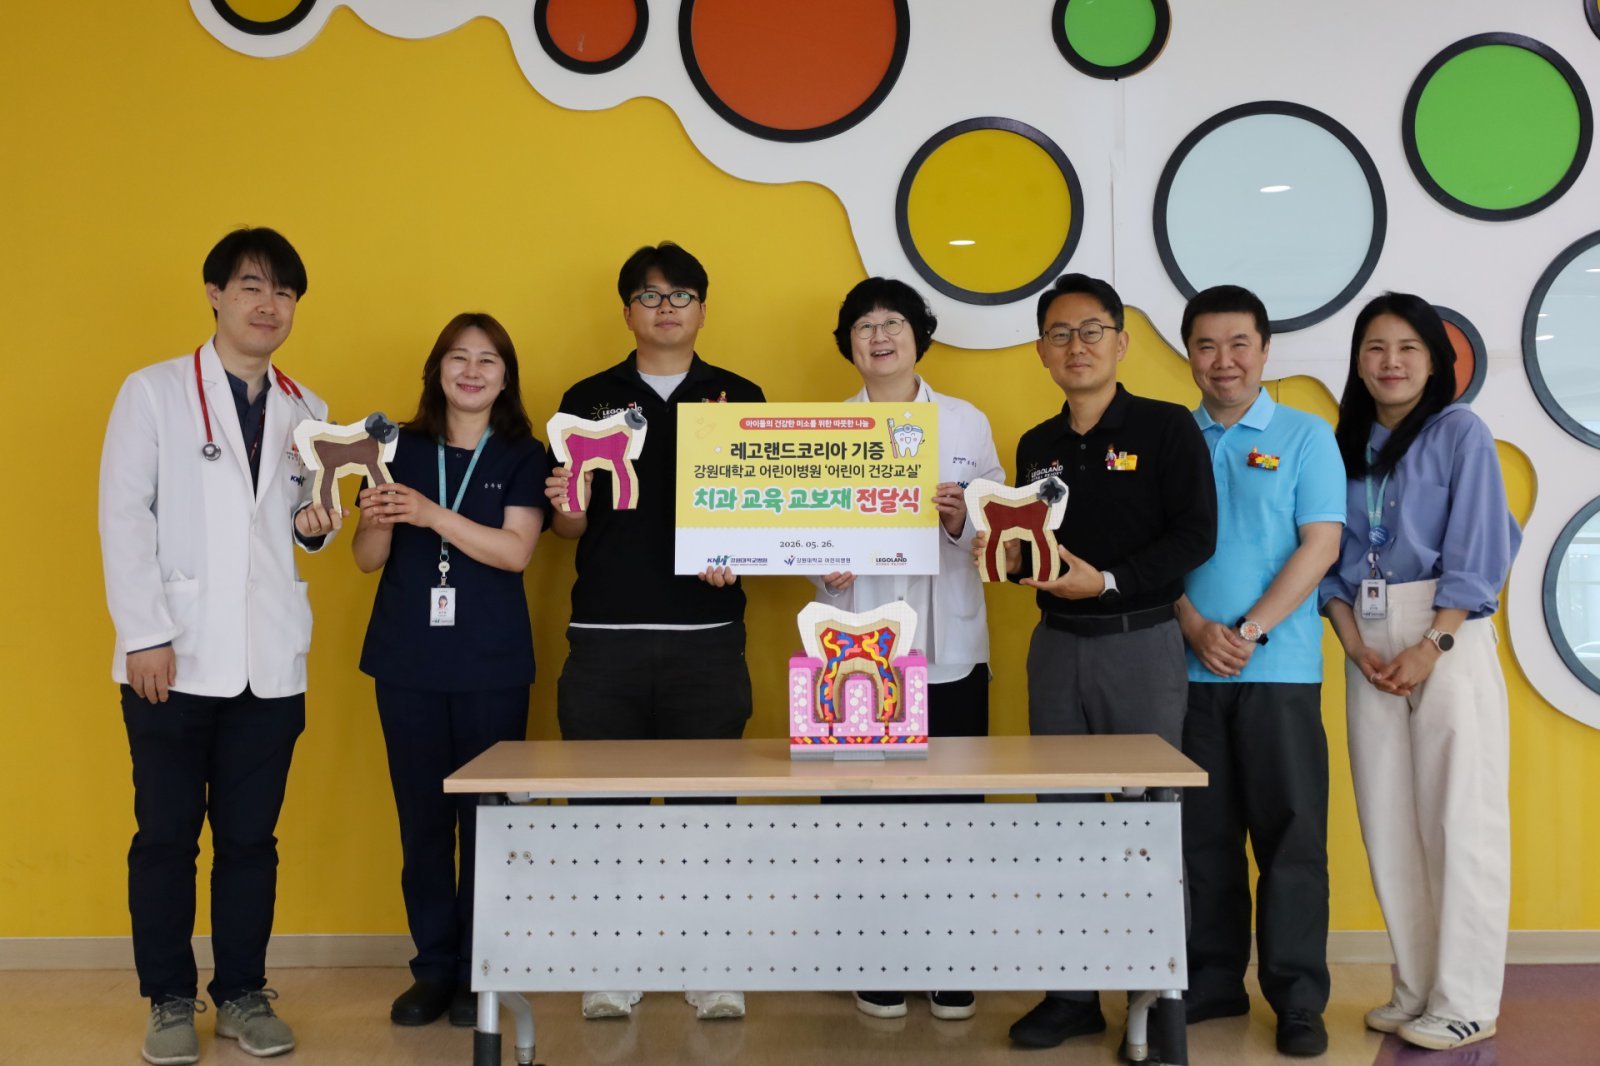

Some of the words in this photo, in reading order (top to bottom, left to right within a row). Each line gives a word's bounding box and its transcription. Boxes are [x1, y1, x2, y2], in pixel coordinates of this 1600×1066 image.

[745, 419, 773, 428] 아이들의
[774, 419, 795, 428] 건강한
[796, 419, 817, 428] 미소를
[817, 419, 832, 428] 위한
[833, 419, 854, 428] 따뜻한
[730, 441, 847, 461] 레고랜드코리아
[852, 441, 885, 460] 기증
[694, 464, 756, 479] 강원대학교
[759, 464, 822, 479] 어린이병원
[694, 488, 737, 510] 치과
[741, 488, 784, 513] 교육
[788, 487, 851, 510] 교보재
[856, 487, 920, 513] 전달식
[779, 540, 804, 549] 2026.
[805, 541, 819, 549] 05.
[821, 540, 835, 548] 26.
